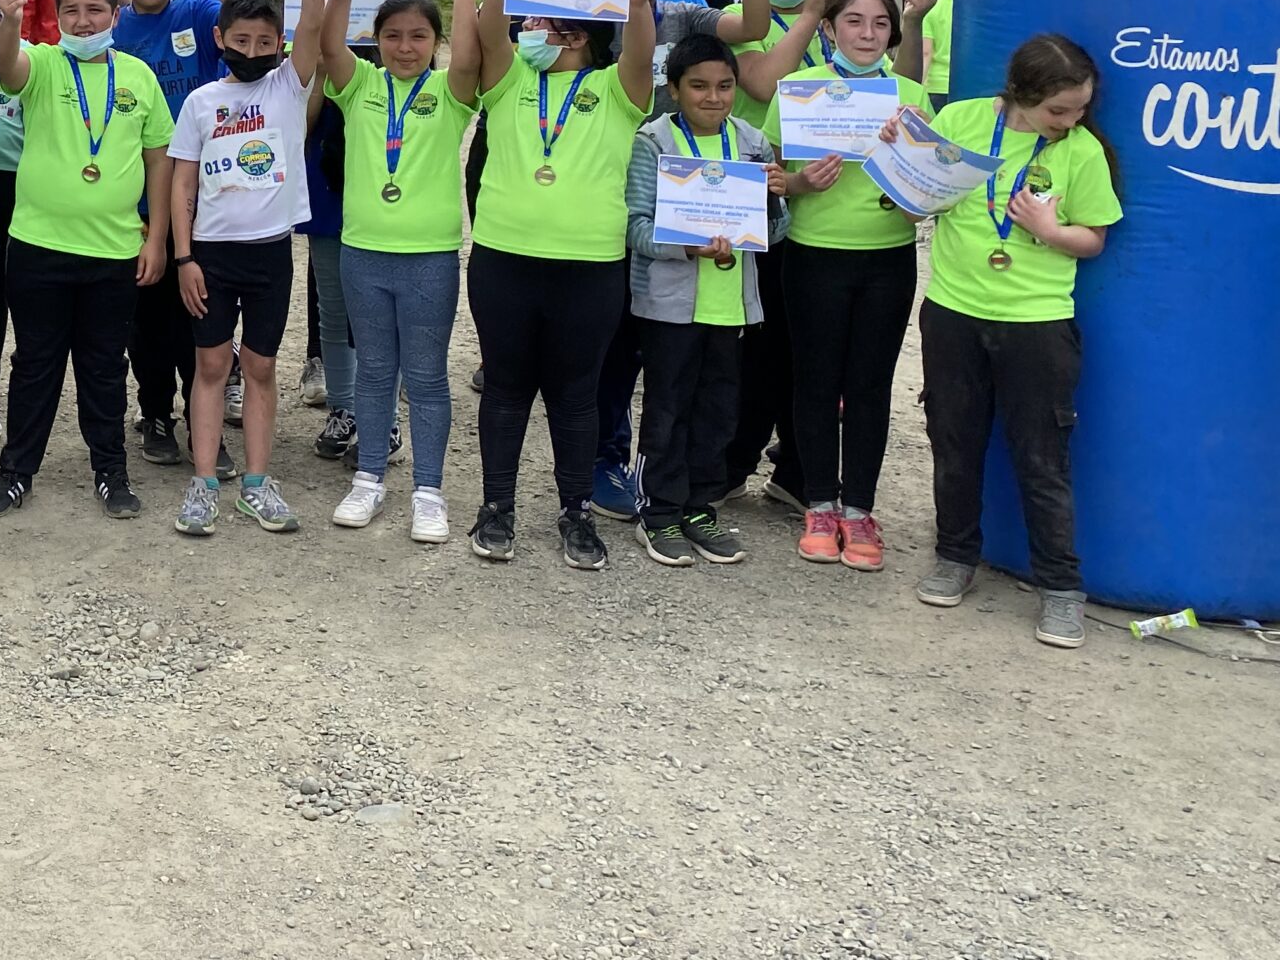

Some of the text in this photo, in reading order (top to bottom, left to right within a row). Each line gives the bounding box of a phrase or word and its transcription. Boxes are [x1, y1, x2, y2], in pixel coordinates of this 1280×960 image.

[1110, 26, 1240, 72] Estamos
[204, 156, 233, 176] 019
[239, 152, 272, 164] CORRIDA
[248, 163, 267, 175] 5K
